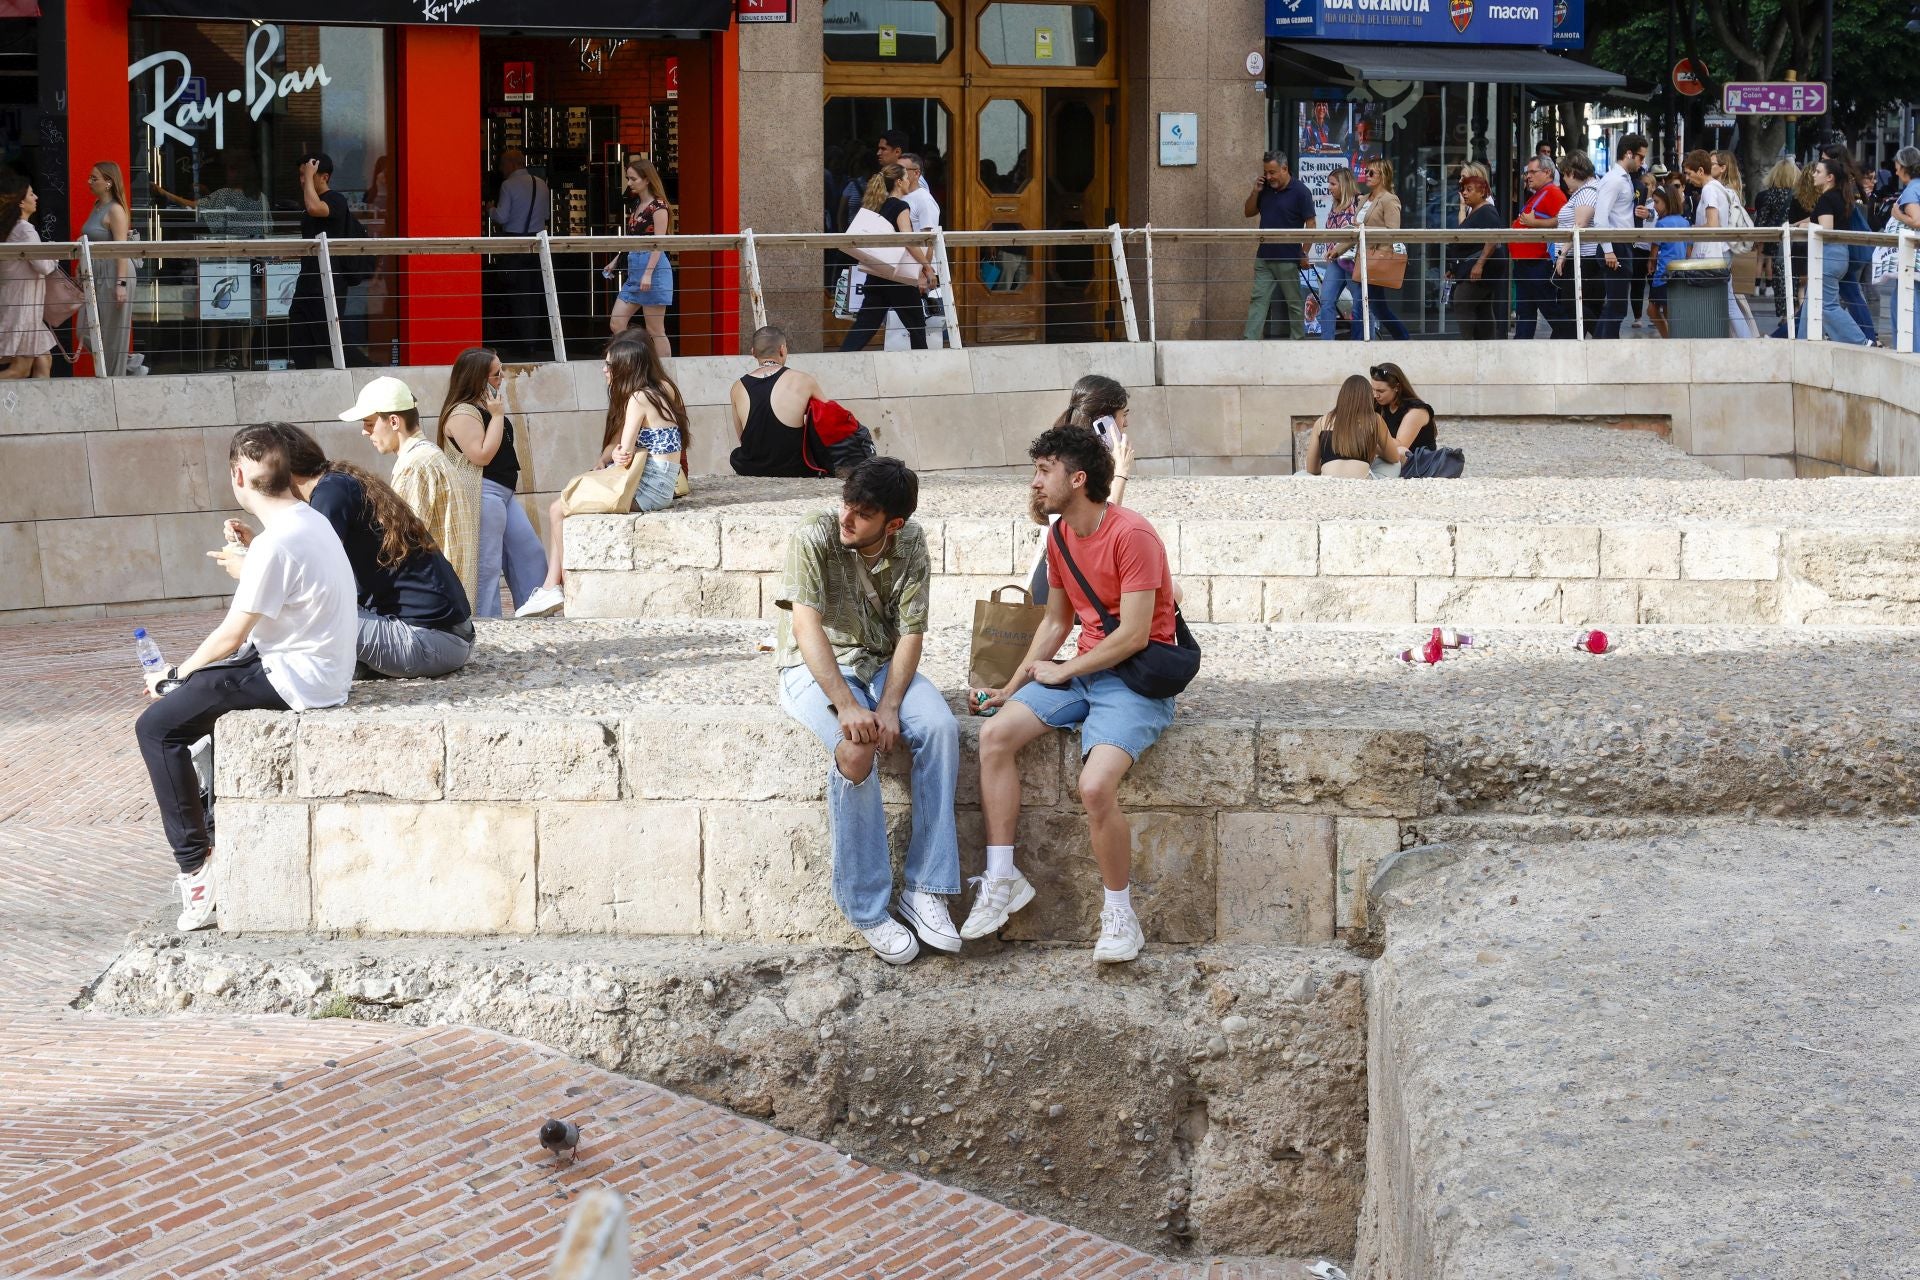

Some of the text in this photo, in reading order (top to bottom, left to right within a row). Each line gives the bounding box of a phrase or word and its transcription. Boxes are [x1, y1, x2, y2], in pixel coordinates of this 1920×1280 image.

[1323, 0, 1353, 9] NDA
[1488, 5, 1539, 20] macron
[1291, 16, 1313, 24] GRANOTA
[1368, 14, 1379, 24] DEL
